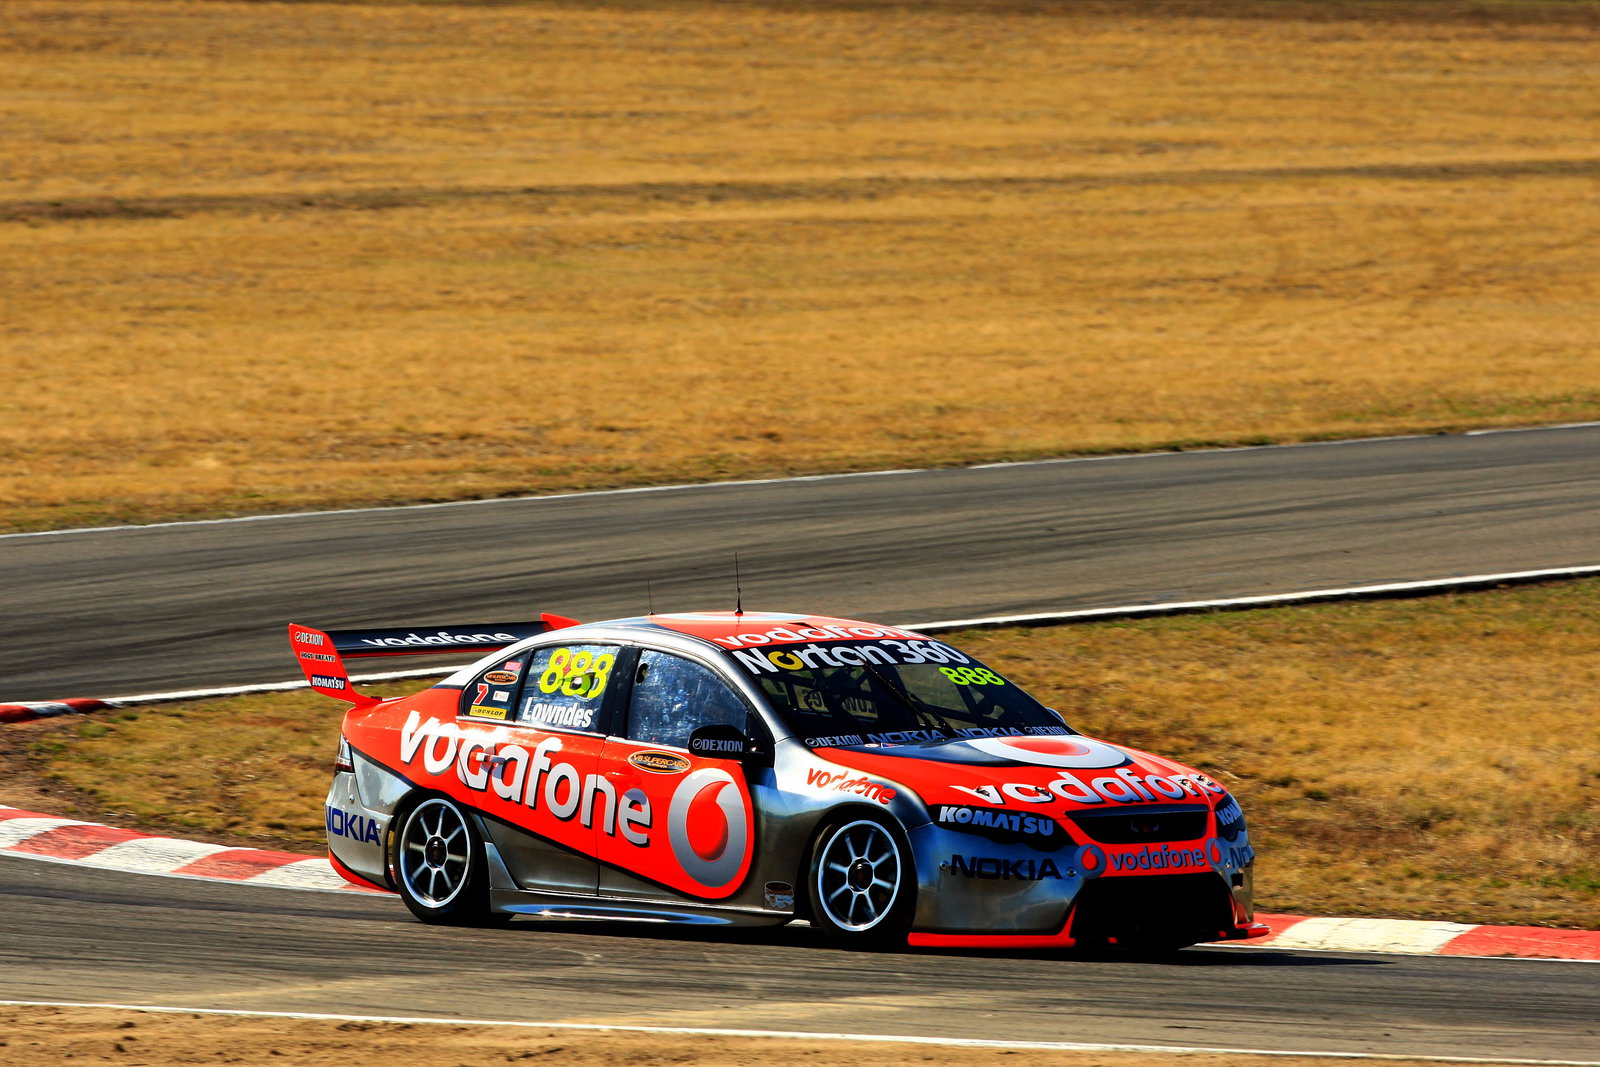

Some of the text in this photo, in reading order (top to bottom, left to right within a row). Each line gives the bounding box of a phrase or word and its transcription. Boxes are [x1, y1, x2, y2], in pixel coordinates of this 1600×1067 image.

[301, 632, 324, 646] DEXION
[360, 631, 520, 647] vodafone
[713, 625, 926, 647] vodafon
[732, 640, 970, 675] Norton 360
[312, 677, 345, 690] KOMATSU
[539, 648, 614, 699] 888
[939, 667, 1005, 686] 888
[473, 683, 489, 705] 7
[477, 708, 504, 716] DUNLOP
[522, 697, 593, 727] Lowndes
[701, 739, 744, 752] DEXION
[816, 734, 864, 747] DEXION
[867, 729, 949, 743] NOKIA
[953, 727, 1025, 738] NOKIA
[400, 710, 652, 848] vodafone
[949, 768, 1224, 804] vodafone
[939, 805, 1054, 836] KOMATSU
[950, 854, 1063, 881] NOKIA
[1108, 844, 1206, 870] vodafone
